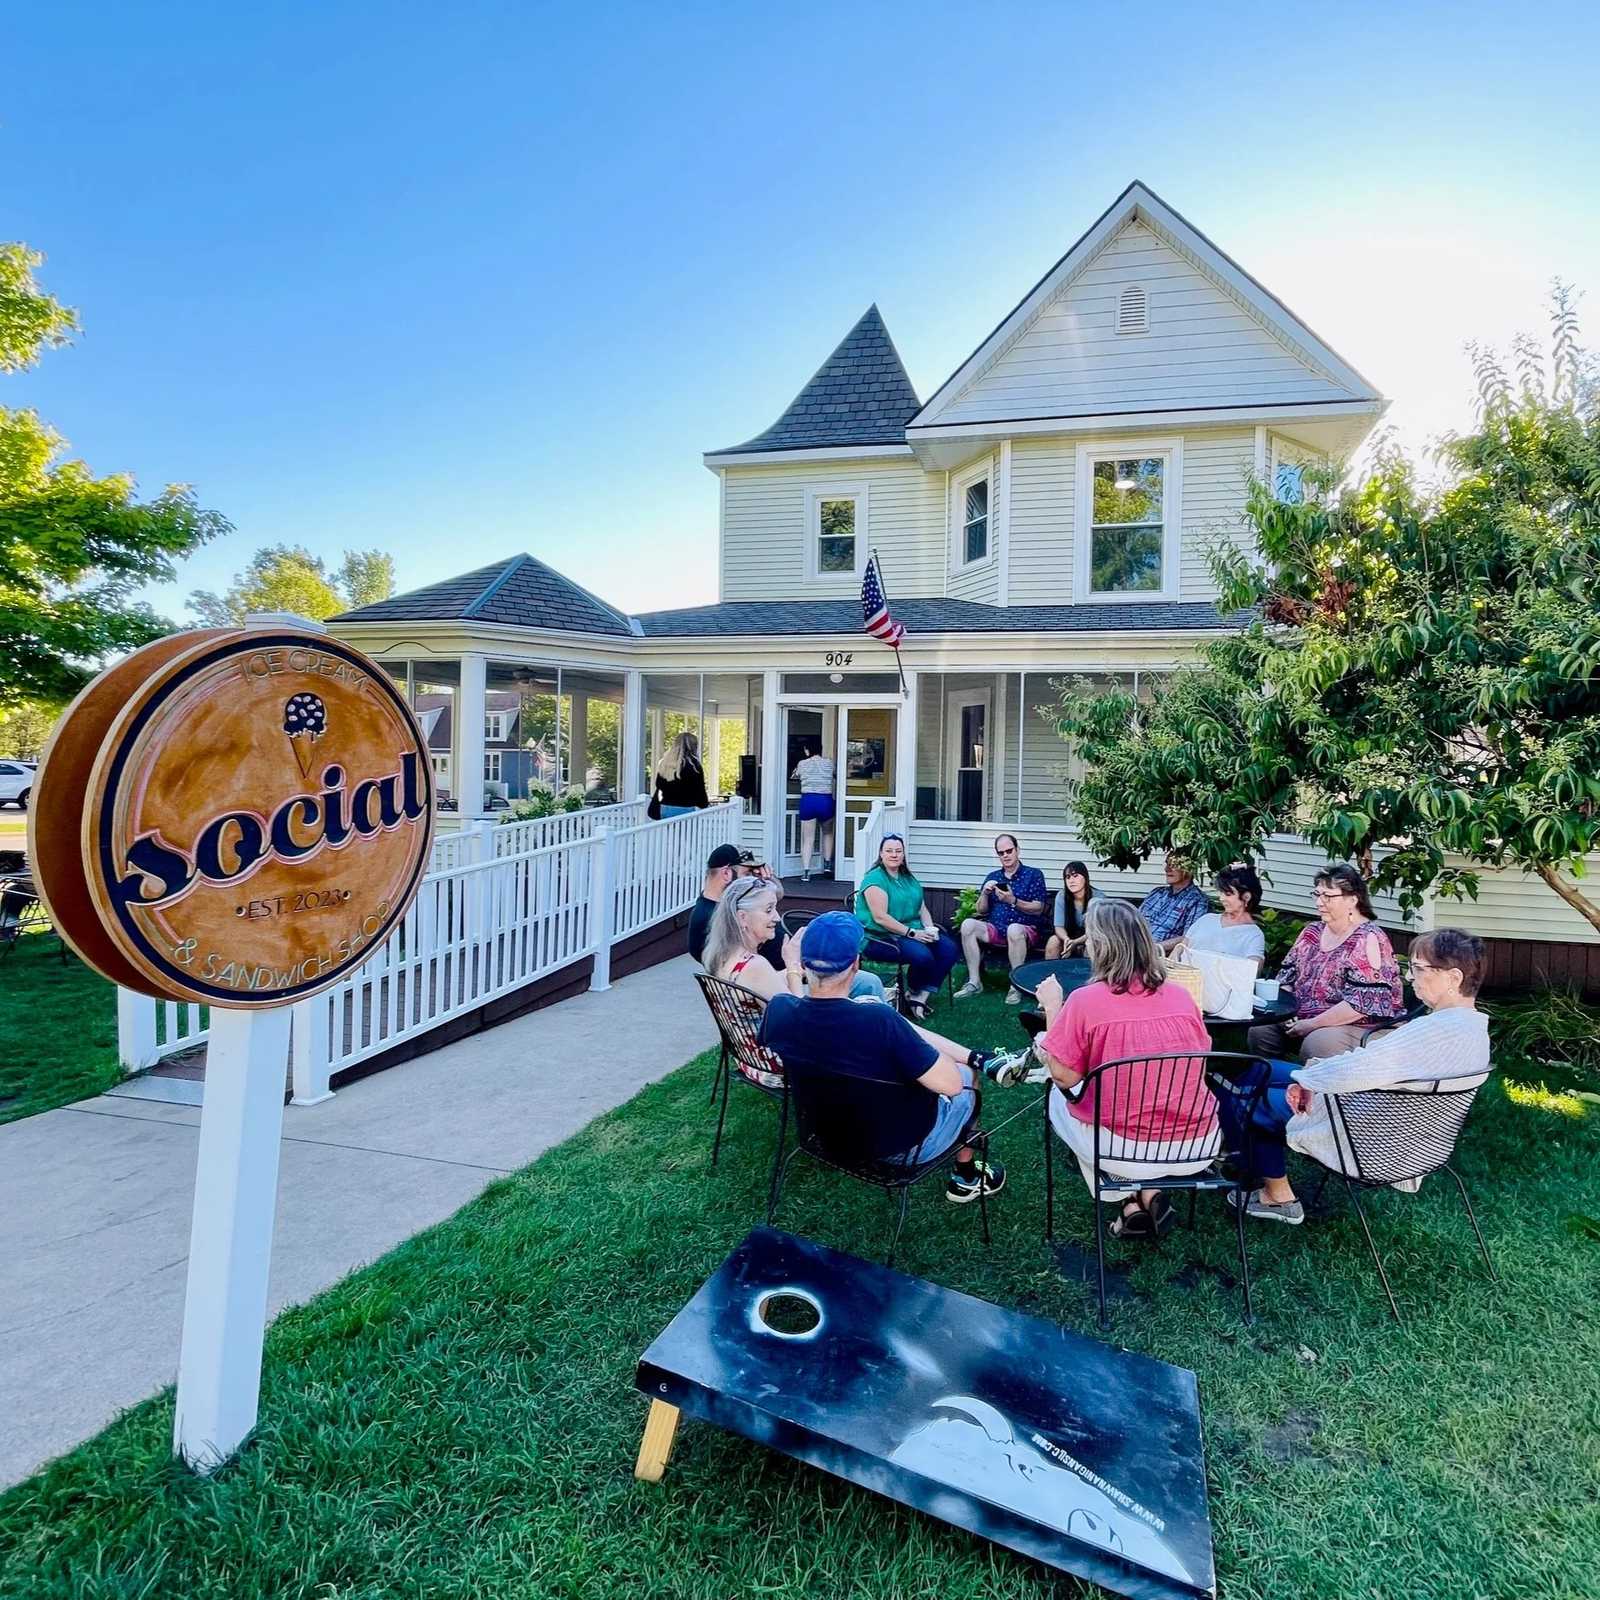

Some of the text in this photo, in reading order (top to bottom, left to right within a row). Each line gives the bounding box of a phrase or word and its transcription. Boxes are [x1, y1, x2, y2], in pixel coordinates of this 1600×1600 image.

[240, 649, 368, 689] ICE CREAM
[825, 653, 853, 666] 904
[294, 888, 342, 913] 2023
[173, 901, 391, 989] & SANDWICH SHOP
